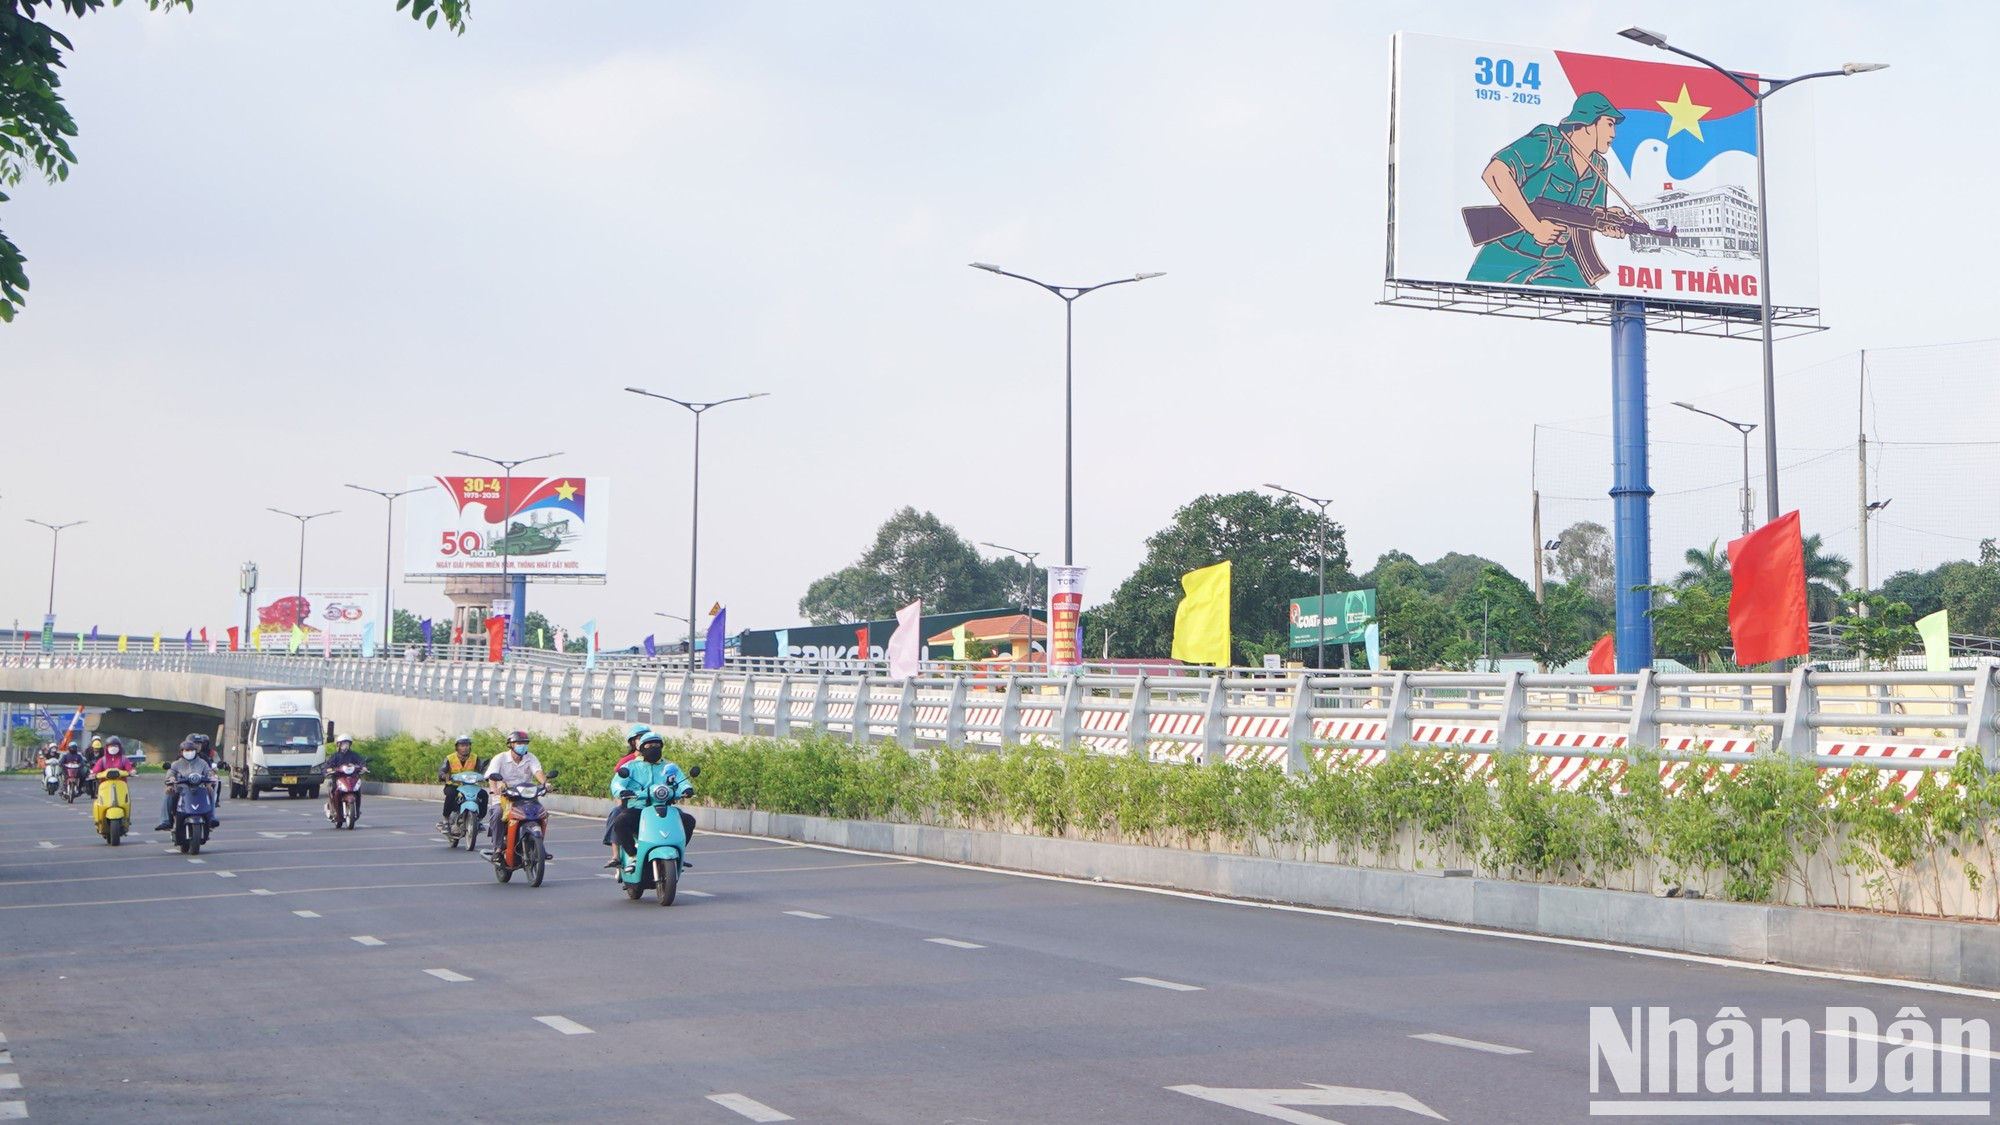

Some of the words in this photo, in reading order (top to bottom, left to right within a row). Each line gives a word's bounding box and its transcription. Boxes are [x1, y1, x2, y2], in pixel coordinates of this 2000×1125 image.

[1475, 56, 1541, 90] 30.4
[1475, 88, 1501, 101] 1975
[1512, 92, 1541, 105] 2025
[1617, 265, 1662, 293] ĐẠI
[1671, 266, 1758, 296] THẮNG
[463, 477, 501, 492] 30-4
[440, 531, 480, 555] 50
